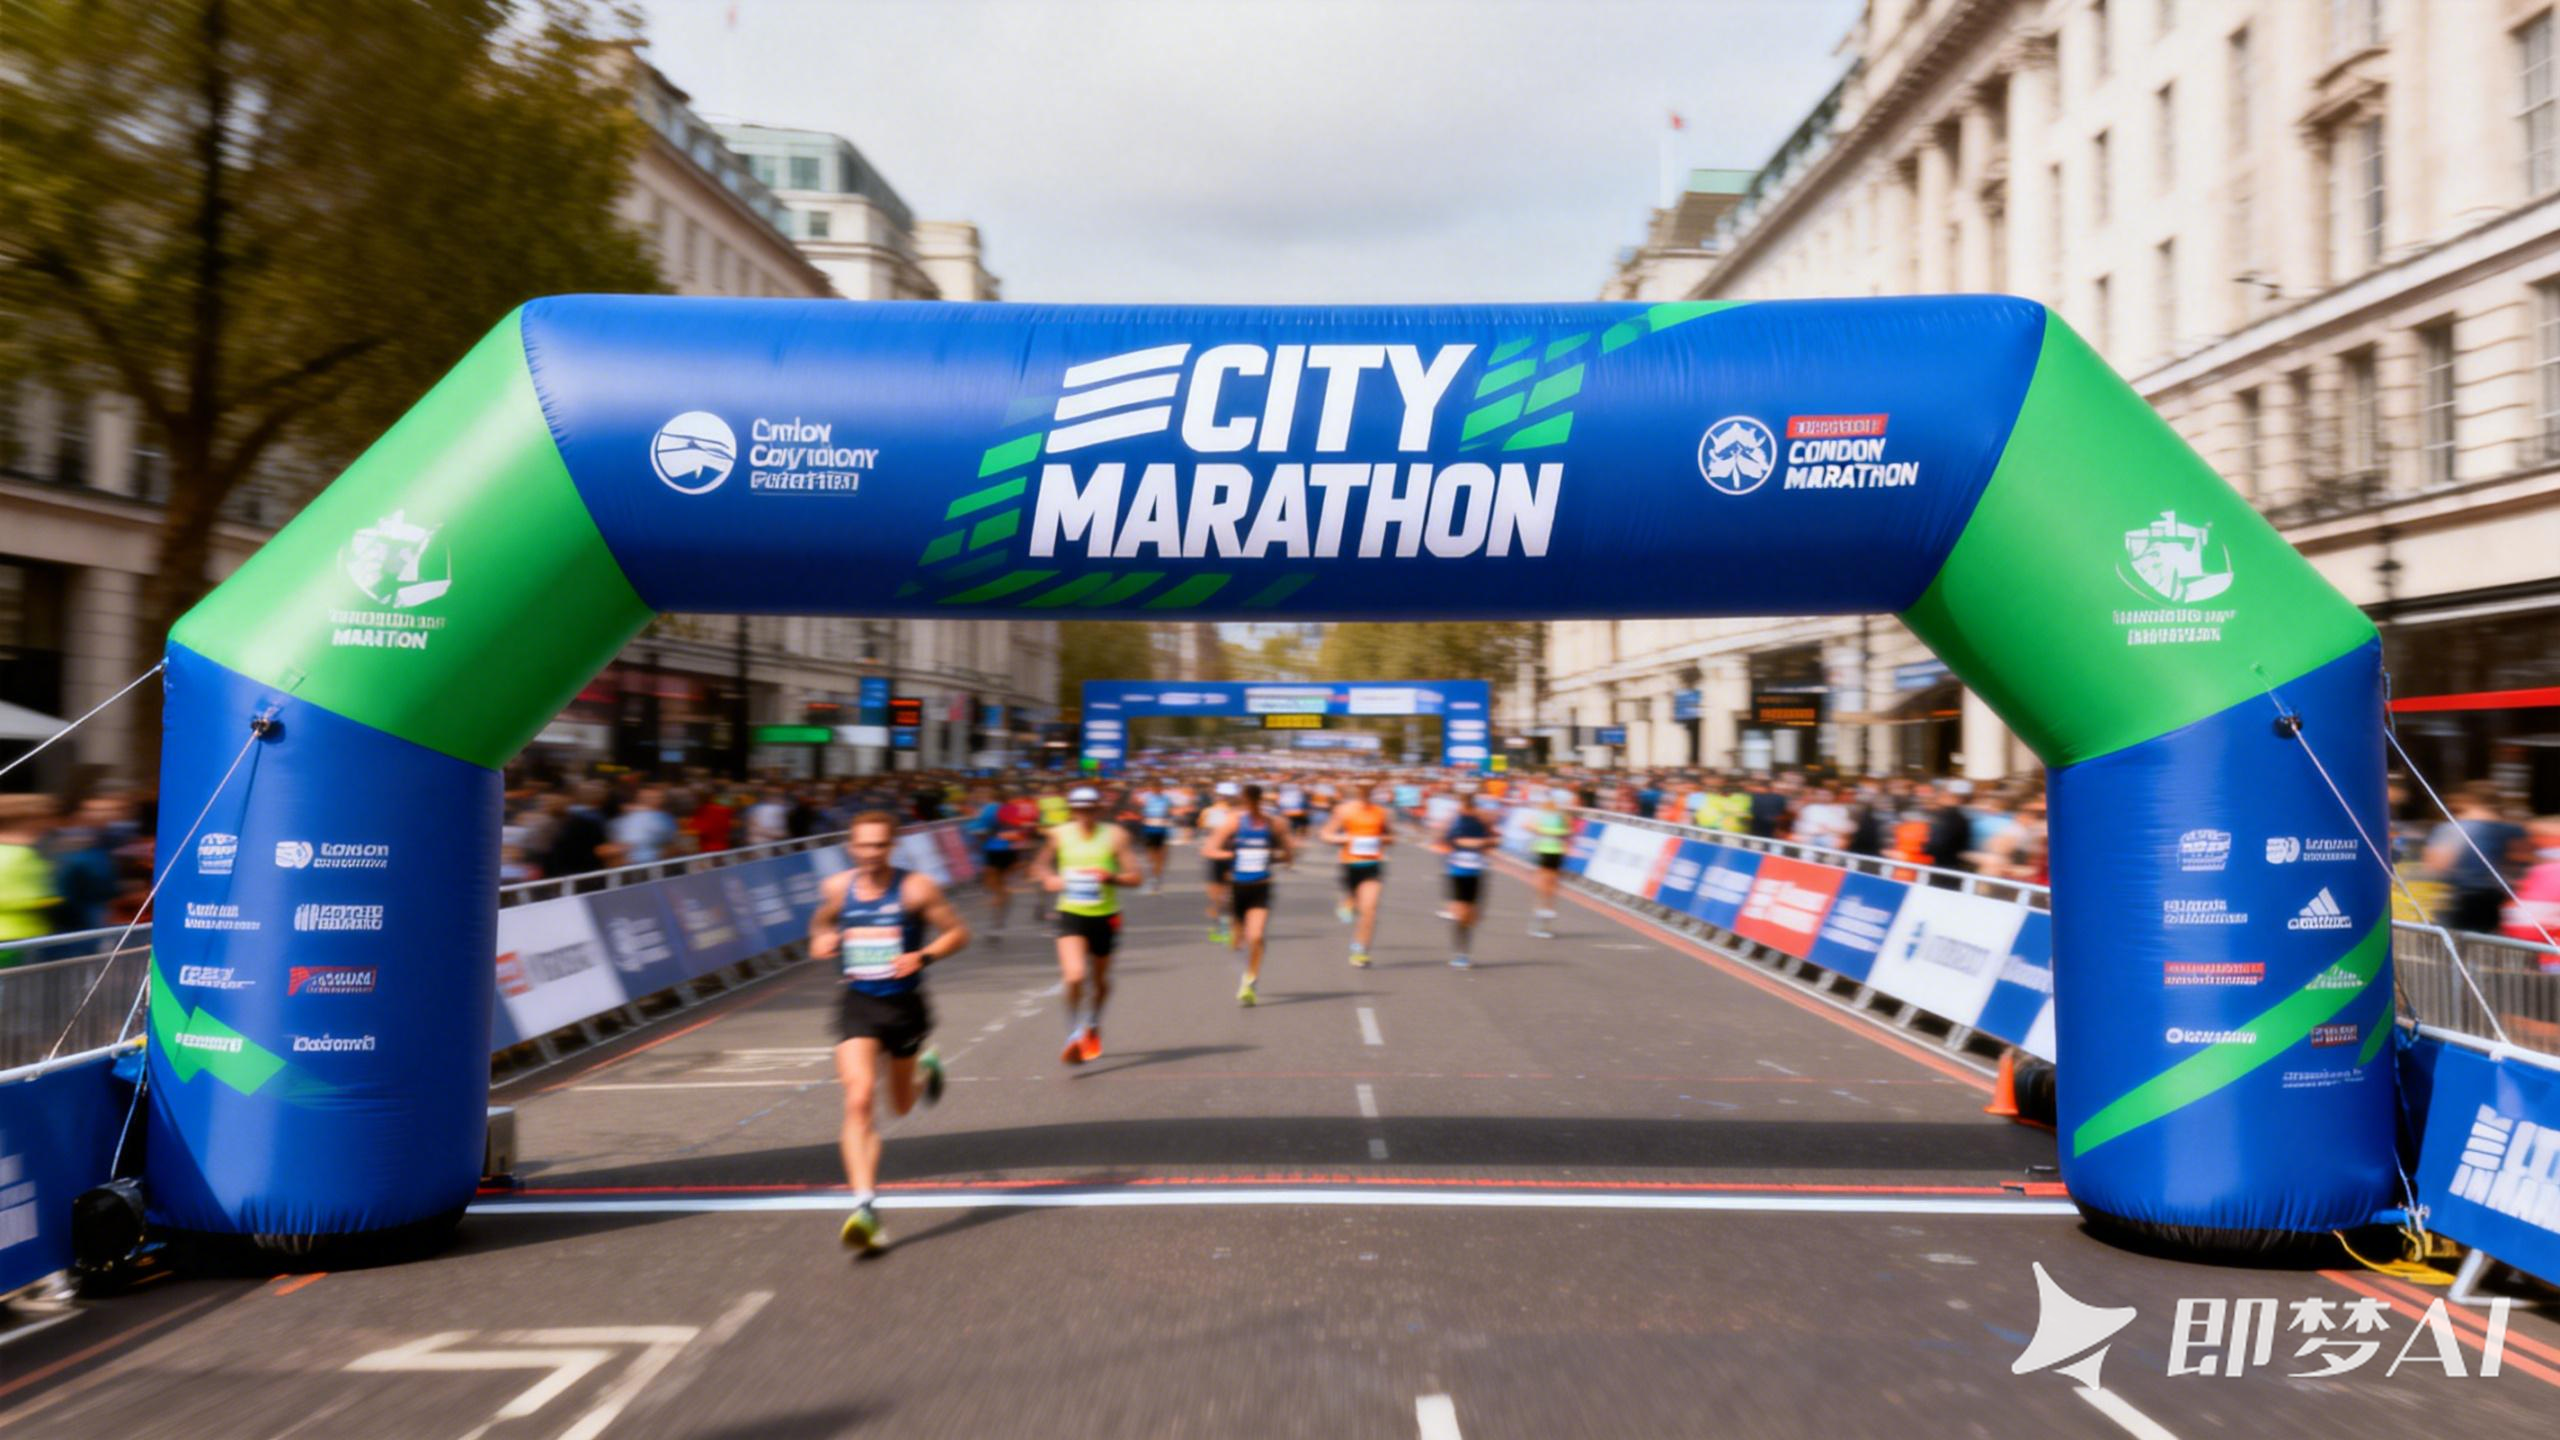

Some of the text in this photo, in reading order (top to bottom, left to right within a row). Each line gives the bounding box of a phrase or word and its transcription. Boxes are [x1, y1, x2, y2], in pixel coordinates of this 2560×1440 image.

[1181, 343, 1477, 453] CITY
[1029, 462, 1564, 558] MARATHON
[1784, 461, 1920, 490] MARATHON
